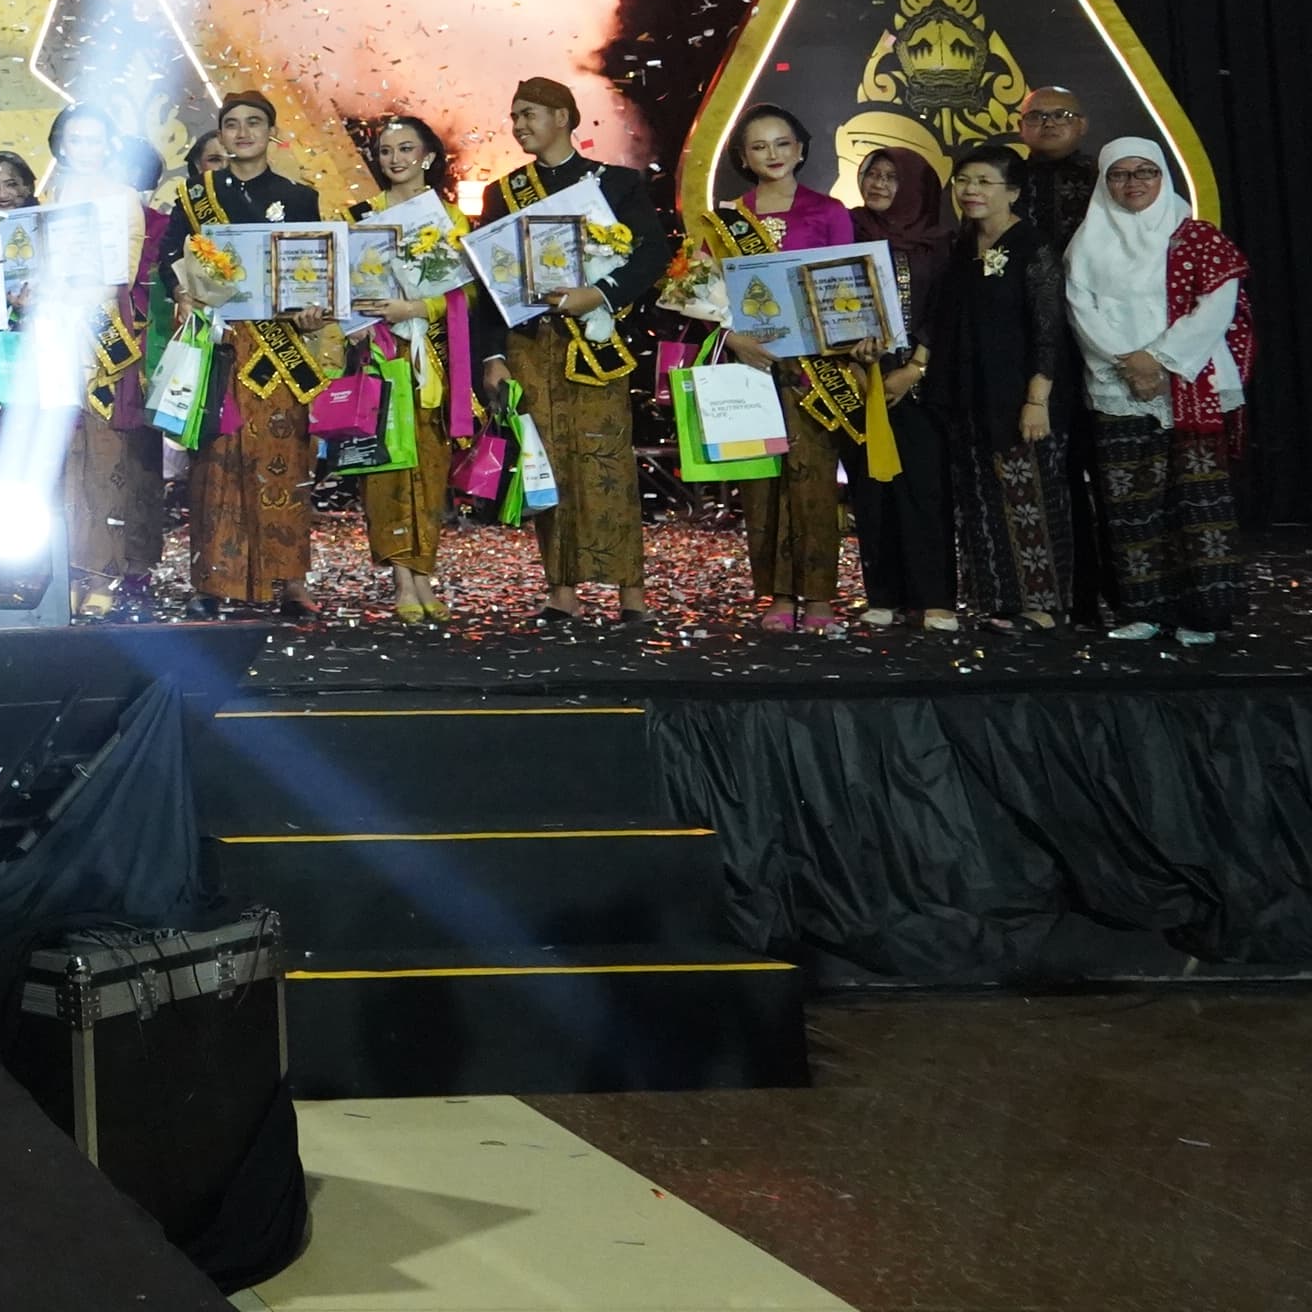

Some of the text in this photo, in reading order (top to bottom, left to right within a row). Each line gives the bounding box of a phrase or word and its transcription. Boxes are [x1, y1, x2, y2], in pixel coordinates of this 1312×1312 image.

[194, 198, 212, 220] MAS
[278, 344, 304, 370] 2024
[833, 388, 863, 414] 2024
